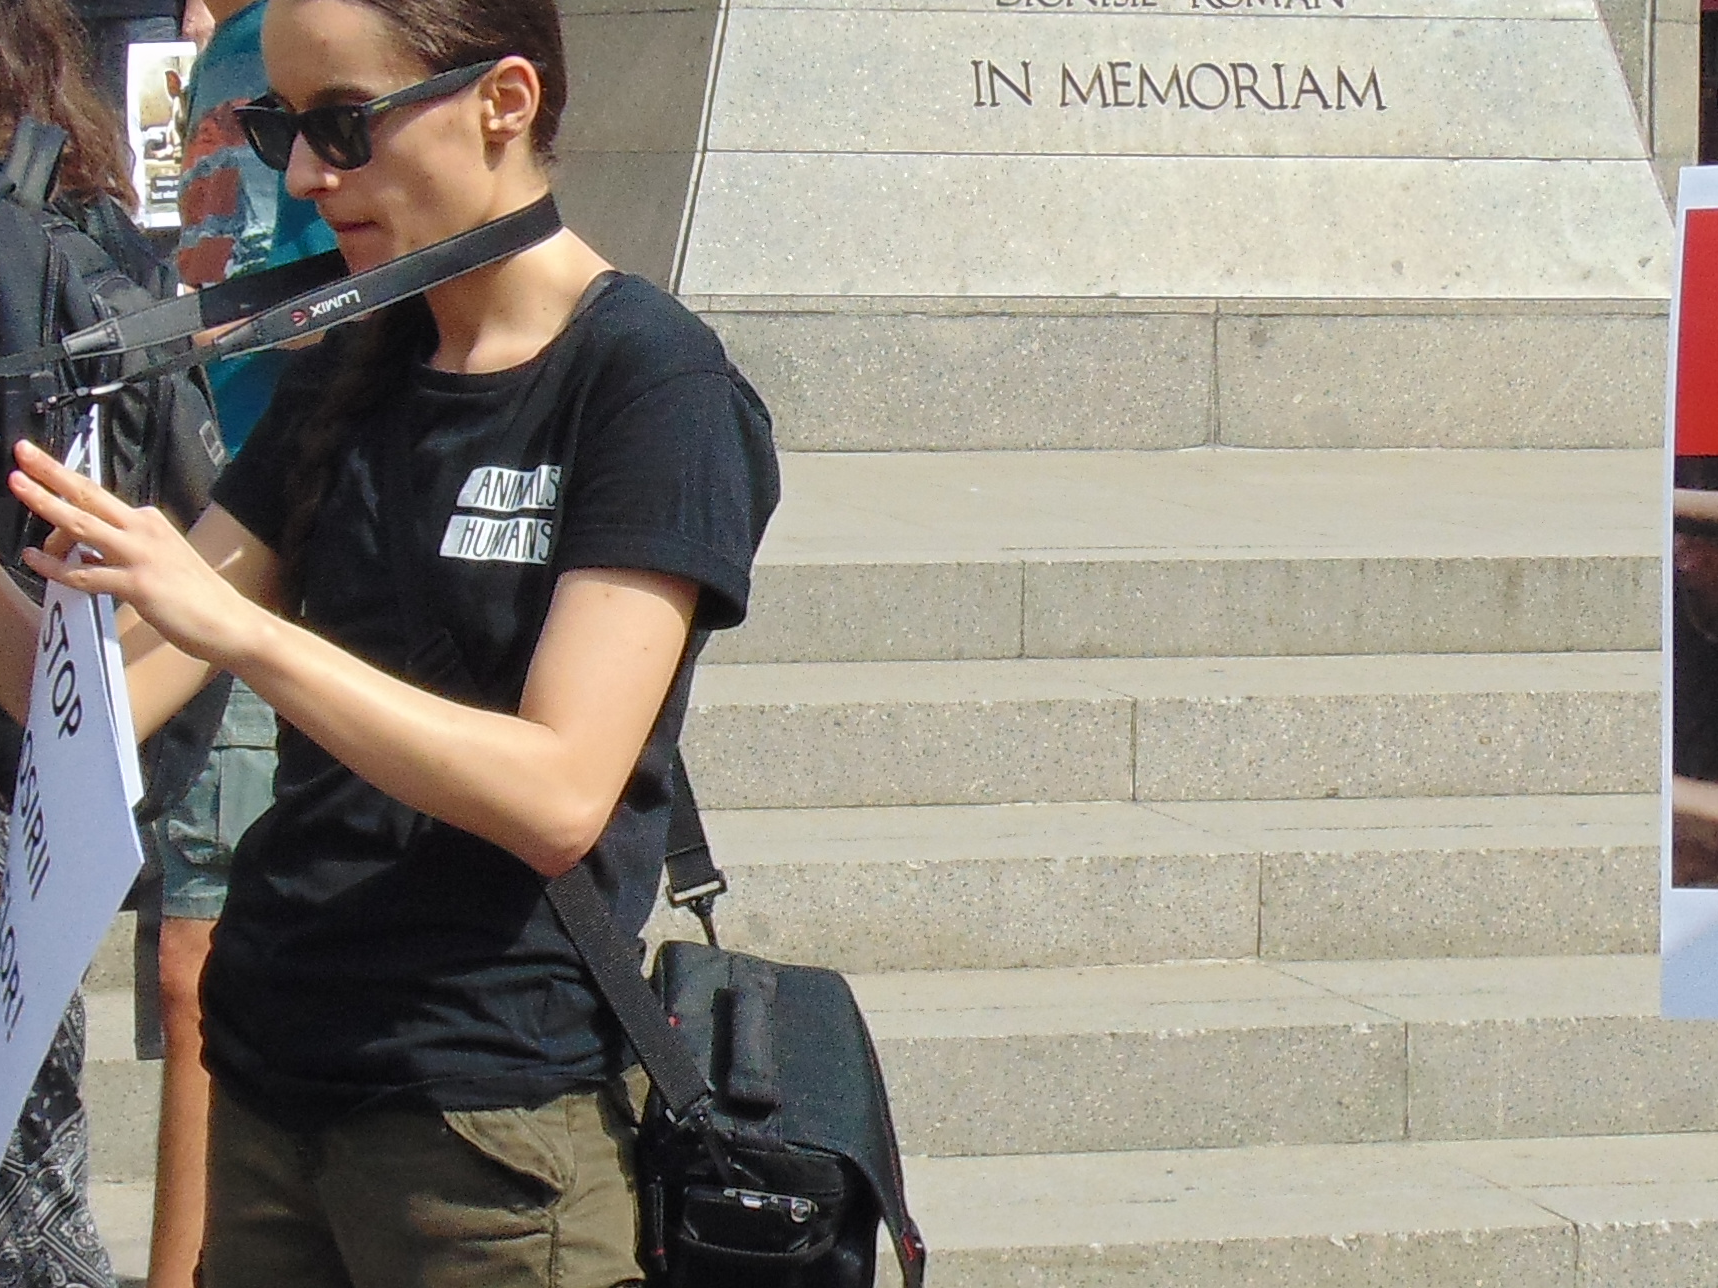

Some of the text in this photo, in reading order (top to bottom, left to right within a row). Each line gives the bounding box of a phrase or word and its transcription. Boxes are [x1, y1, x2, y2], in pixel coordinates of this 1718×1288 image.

[970, 59, 1389, 112] IN MEMORIAM
[309, 289, 361, 318] LUMIX
[457, 518, 553, 561] HUMANS
[43, 599, 83, 740] STOP
